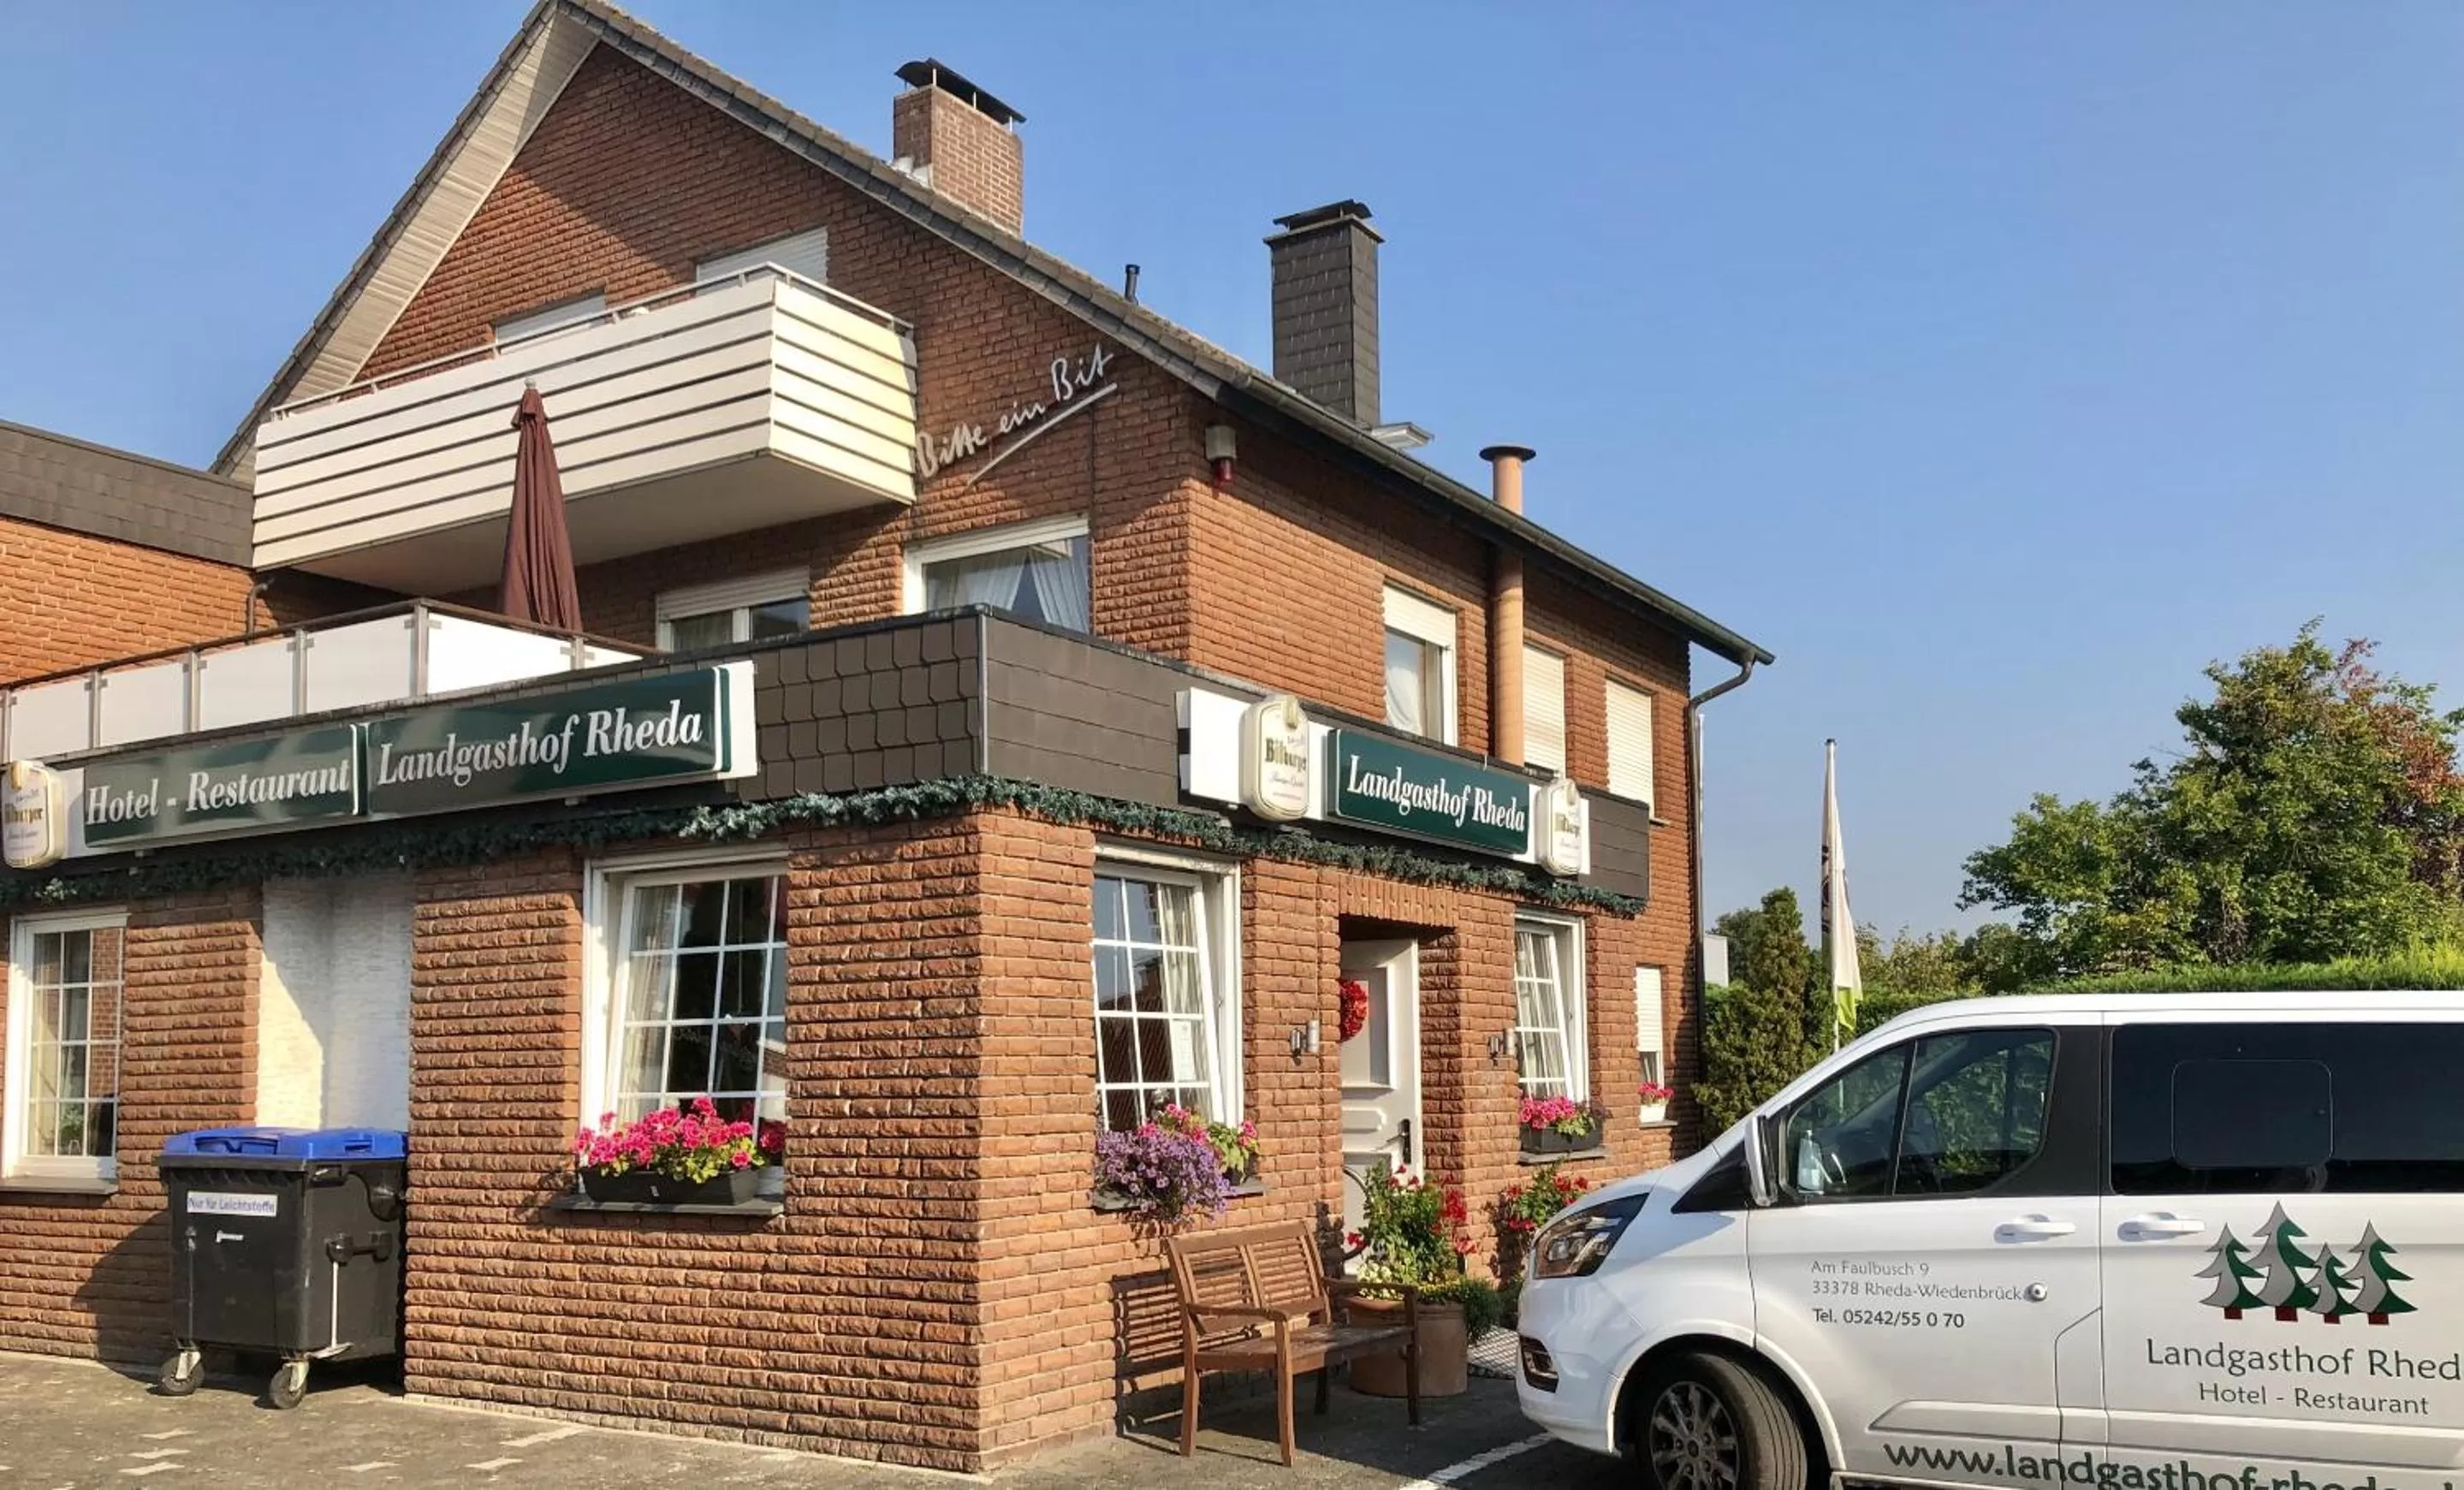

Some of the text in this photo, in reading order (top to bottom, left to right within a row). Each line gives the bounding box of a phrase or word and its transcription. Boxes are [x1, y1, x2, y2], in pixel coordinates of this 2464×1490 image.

[916, 342, 1113, 478] Bitte ein Bit
[377, 700, 703, 787] Landgasthof Rheda
[86, 778, 159, 825] Hotel
[186, 759, 350, 812] Restaurant
[1347, 754, 1471, 828] Landgasthof
[1472, 787, 1526, 832] Rheda
[1811, 1261, 1929, 1276] Am Faulbusch 9
[1813, 1280, 2022, 1301] 33378 Rheda-Wiedenbrück
[1813, 1308, 1964, 1327] Tel. 05242/55 0 70
[2147, 1338, 2354, 1377] Landgasthof
[2199, 1382, 2267, 1404] Hotel
[2295, 1387, 2429, 1415] Restaurant
